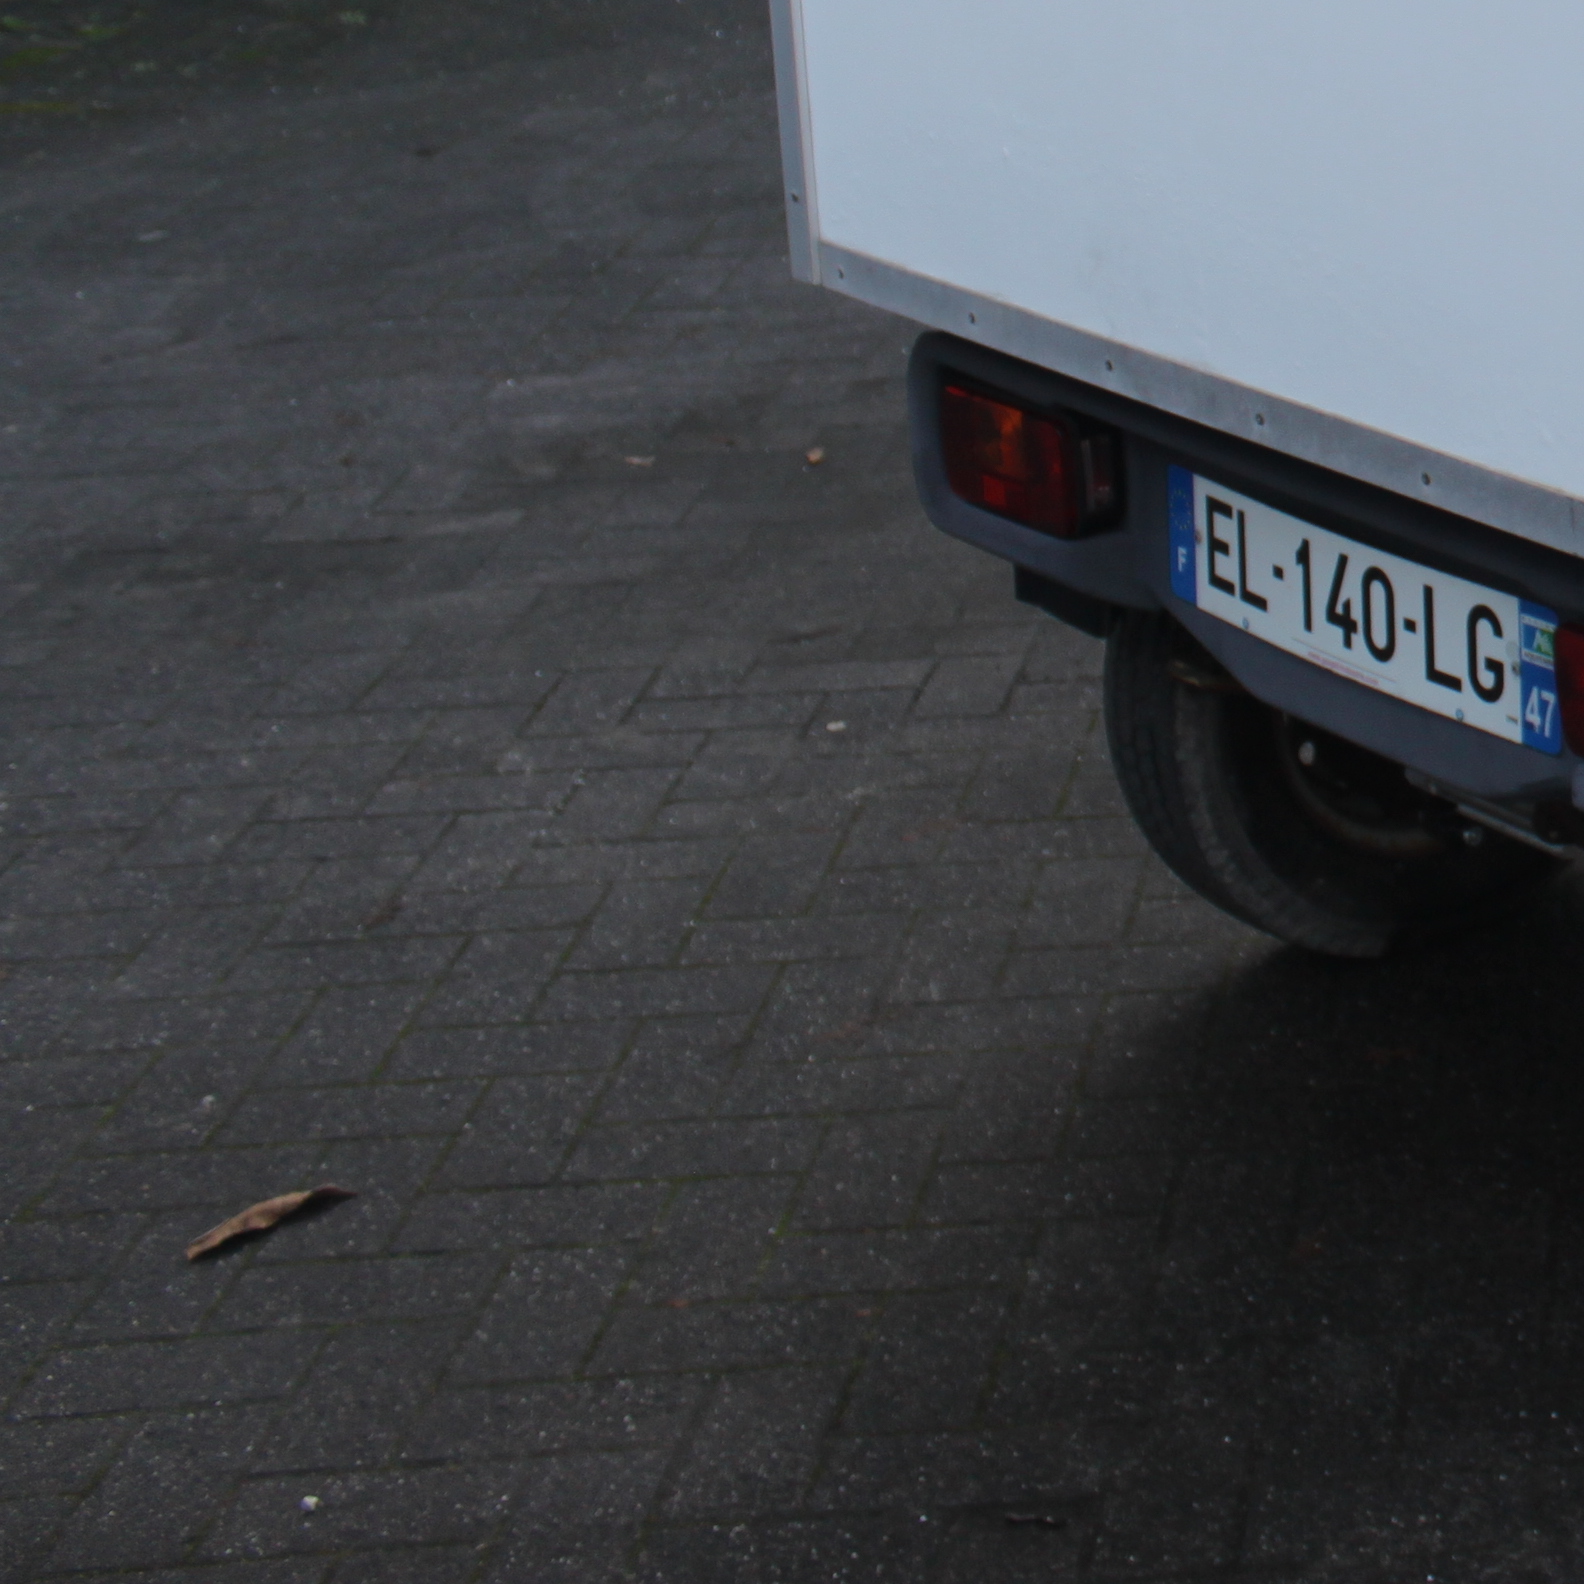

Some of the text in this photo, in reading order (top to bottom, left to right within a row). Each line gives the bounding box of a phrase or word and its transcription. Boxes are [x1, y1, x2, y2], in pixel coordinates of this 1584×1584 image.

[1177, 546, 1188, 572] F
[1205, 494, 1506, 703] EL-140-LG
[1525, 686, 1556, 738] 47
